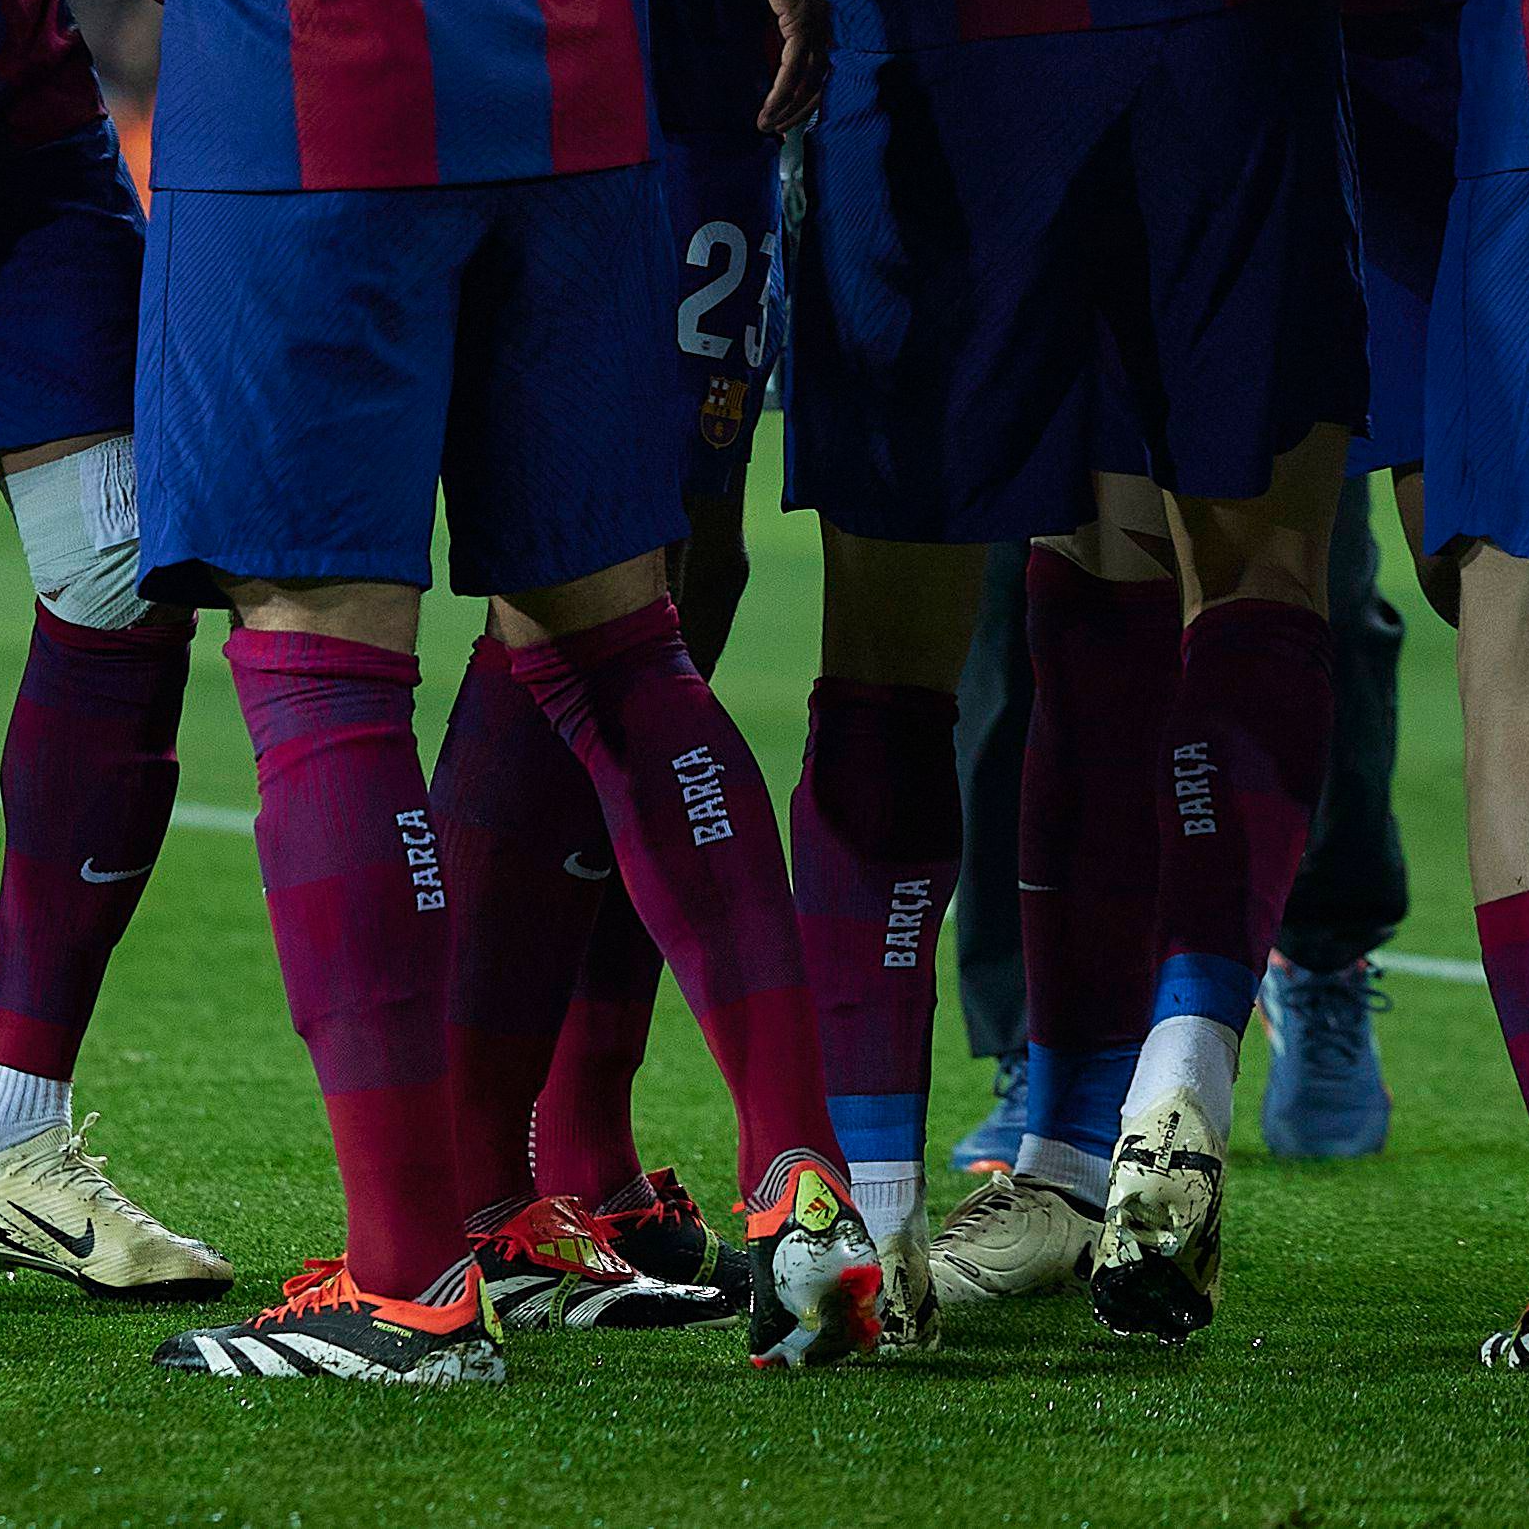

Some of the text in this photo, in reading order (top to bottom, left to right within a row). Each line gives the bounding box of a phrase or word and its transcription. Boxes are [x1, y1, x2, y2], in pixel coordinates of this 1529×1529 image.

[671, 745, 734, 847] BARÇA
[1174, 741, 1218, 836] BARÇA
[396, 808, 447, 912] BARÇA
[883, 878, 931, 969] BARÇA
